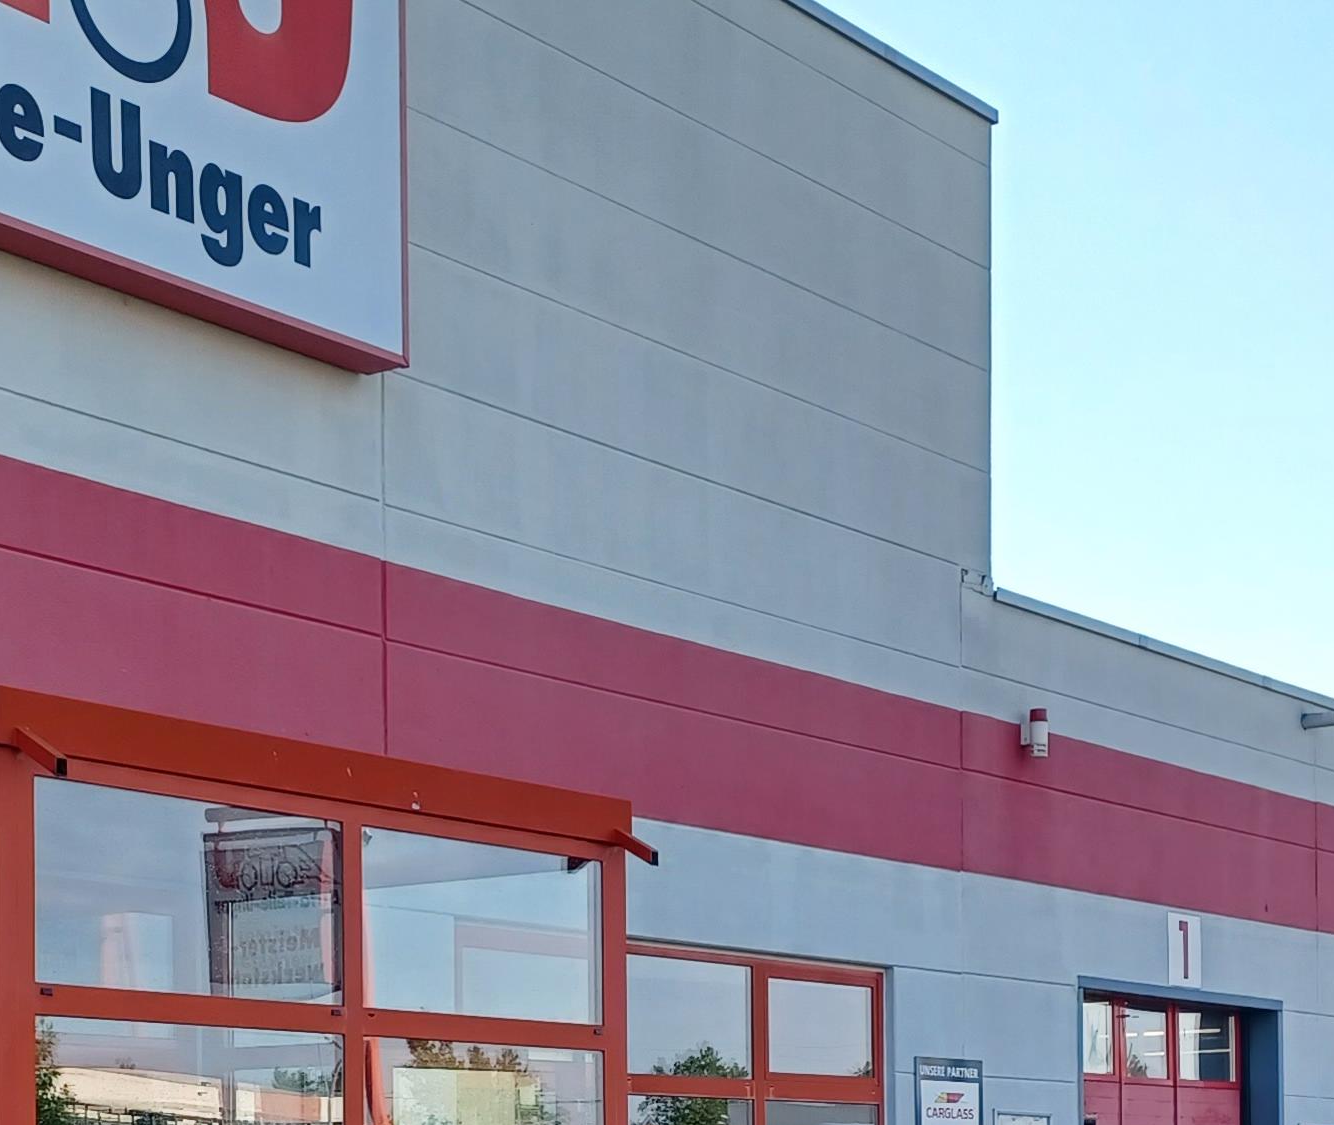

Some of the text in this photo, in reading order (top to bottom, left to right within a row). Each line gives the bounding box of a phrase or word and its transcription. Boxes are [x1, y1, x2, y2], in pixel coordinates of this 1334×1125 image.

[1178, 920, 1189, 979] 1
[919, 1064, 980, 1079] UNSERE PARTNER
[926, 1107, 975, 1120] CARGLASS
